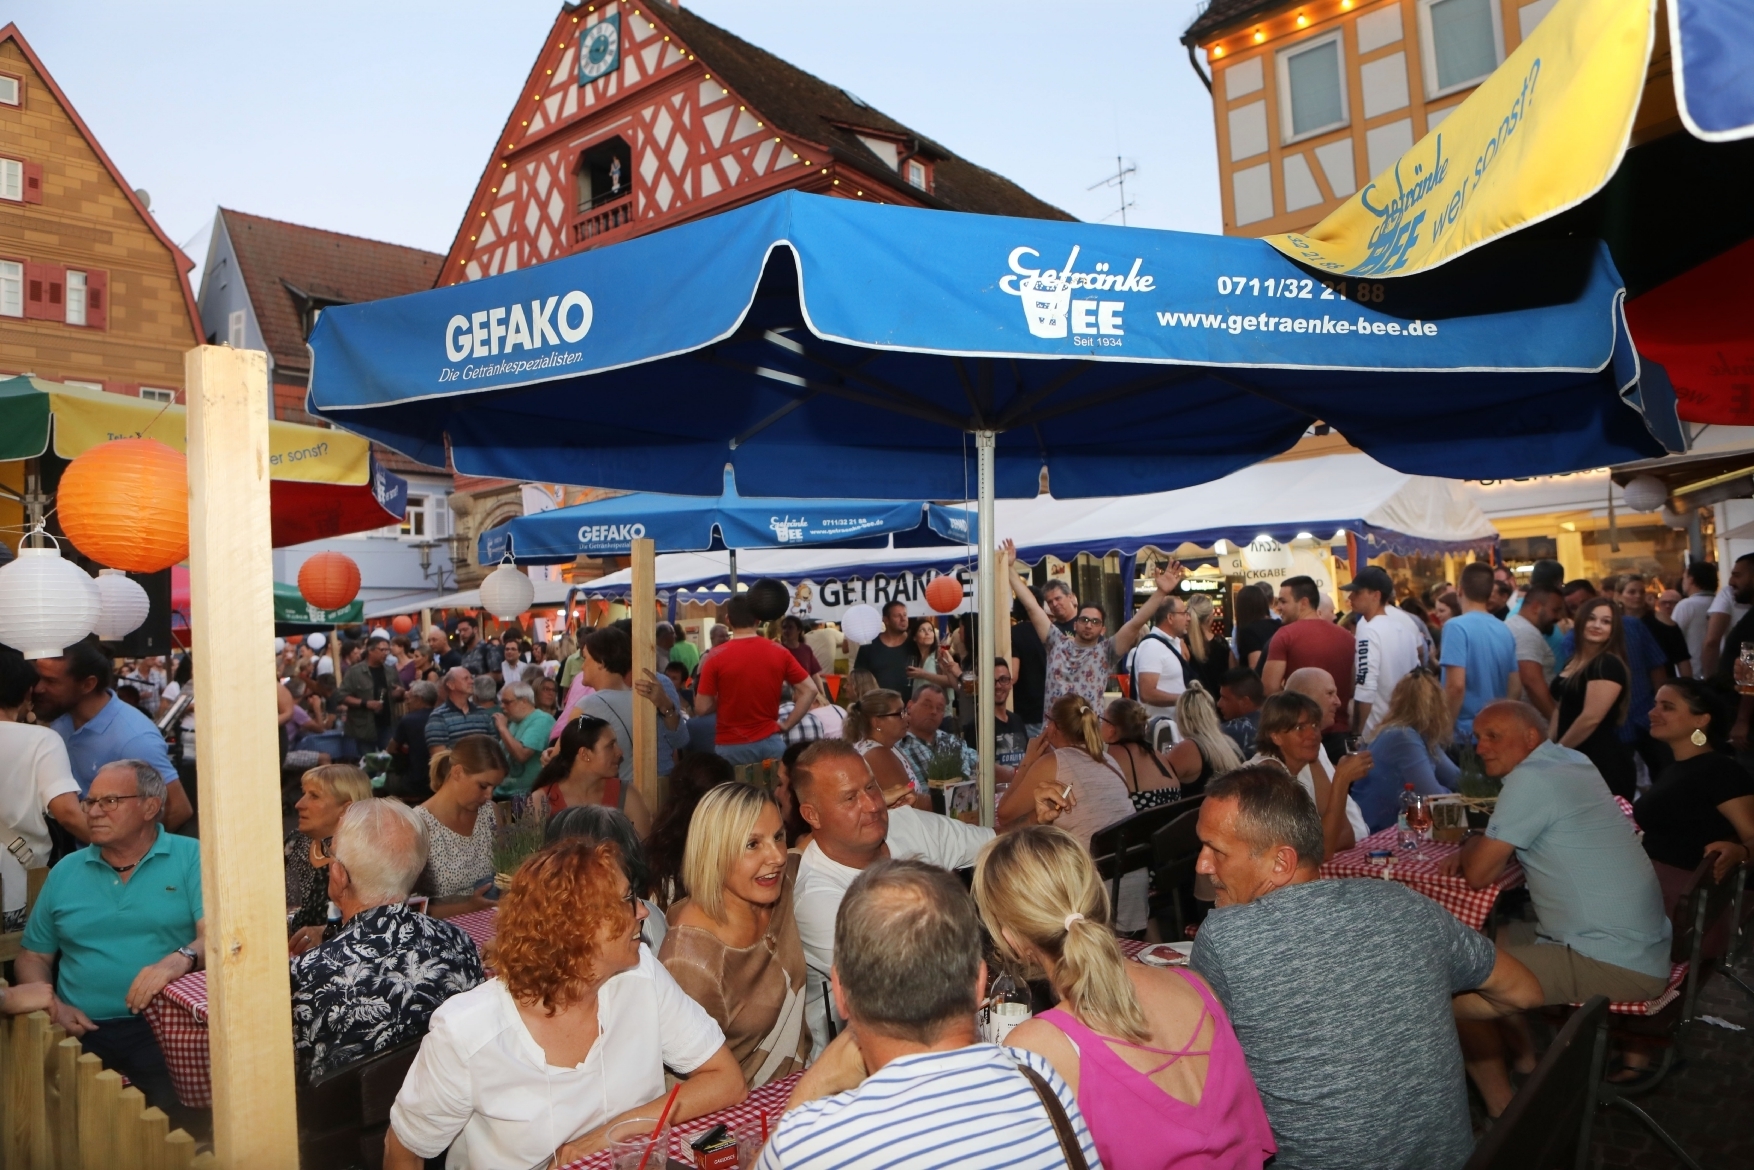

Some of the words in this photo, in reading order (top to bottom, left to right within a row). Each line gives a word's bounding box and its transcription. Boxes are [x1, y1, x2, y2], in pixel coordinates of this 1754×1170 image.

[1433, 175, 1470, 244] wer
[1473, 57, 1541, 191] sonst?
[999, 244, 1157, 297] Getränke
[1217, 275, 1313, 299] 0711/32
[1320, 281, 1347, 301] 21
[1356, 283, 1385, 303] 88
[445, 290, 594, 363] GEFAKO
[1156, 311, 1438, 337] www.getraenke-bee.de
[1073, 336, 1094, 347] Seit
[1097, 336, 1123, 347] 1934
[438, 368, 459, 383] Die
[462, 351, 584, 380] Getränkespezialisten.
[270, 453, 284, 465] er
[287, 442, 329, 462] sonst?
[578, 523, 645, 543] GEFAKO
